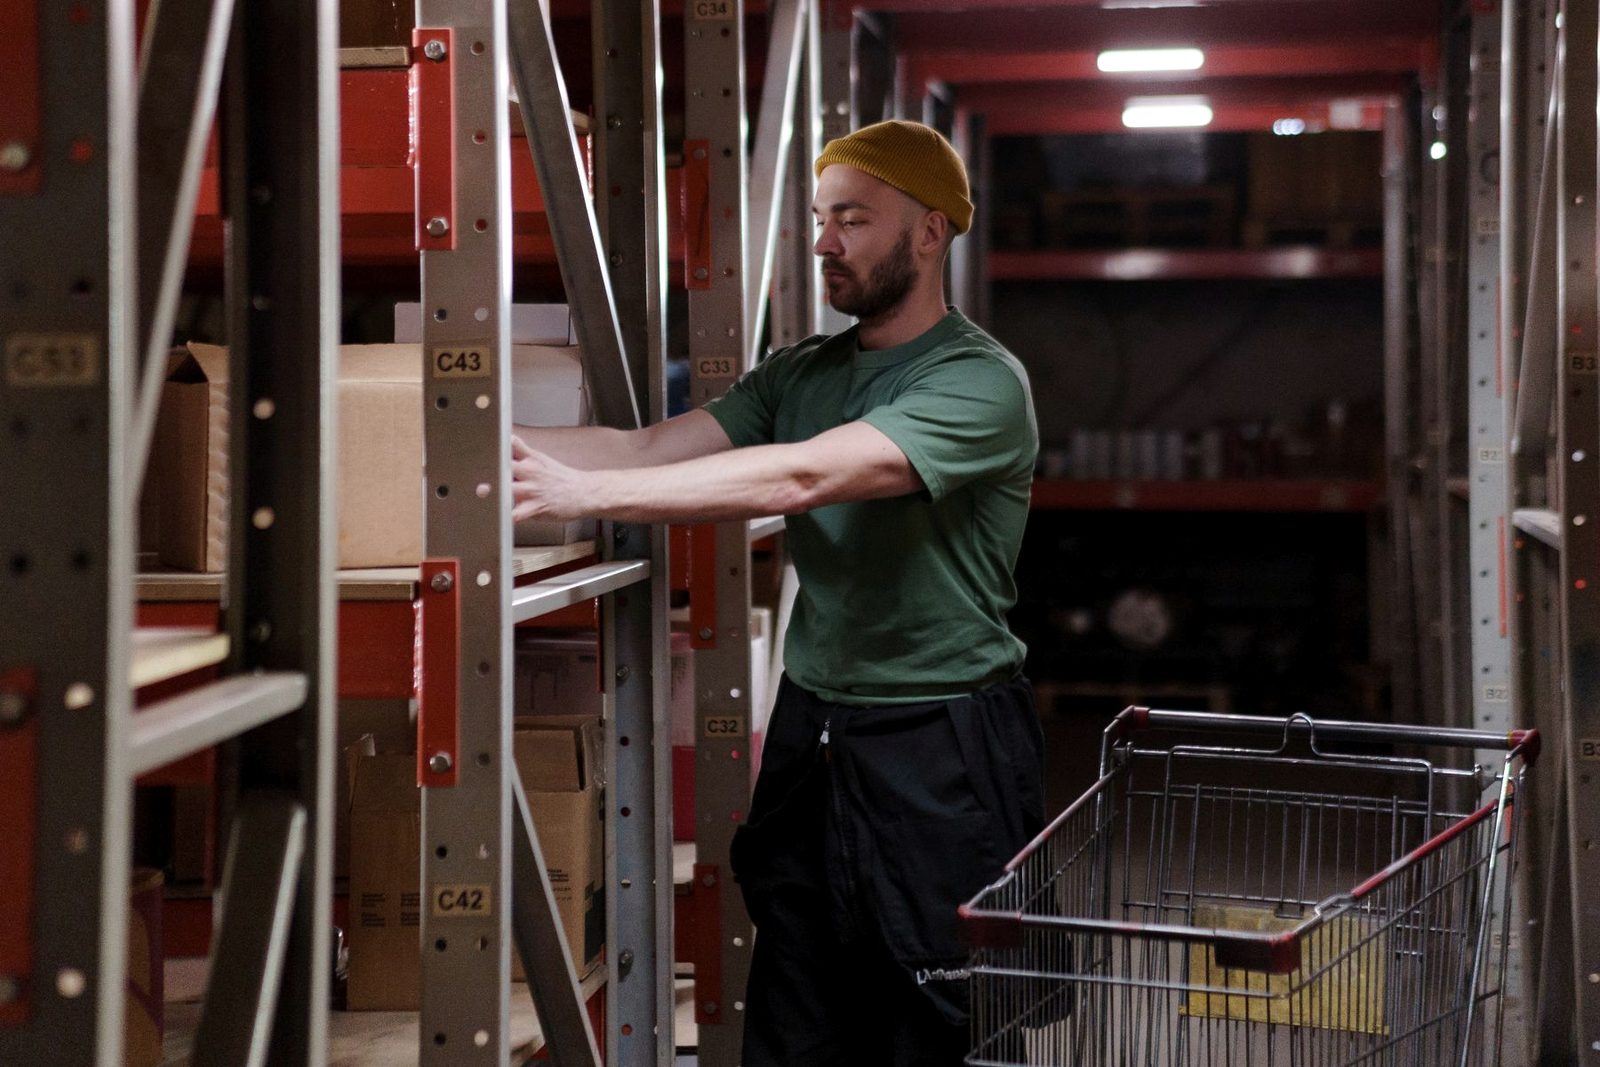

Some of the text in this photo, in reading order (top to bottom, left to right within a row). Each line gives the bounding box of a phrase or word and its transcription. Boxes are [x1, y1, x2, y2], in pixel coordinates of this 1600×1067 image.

[697, 2, 727, 16] C34
[437, 352, 481, 372] C43
[700, 360, 730, 374] C33
[707, 719, 737, 733] C32
[439, 890, 483, 911] C42
